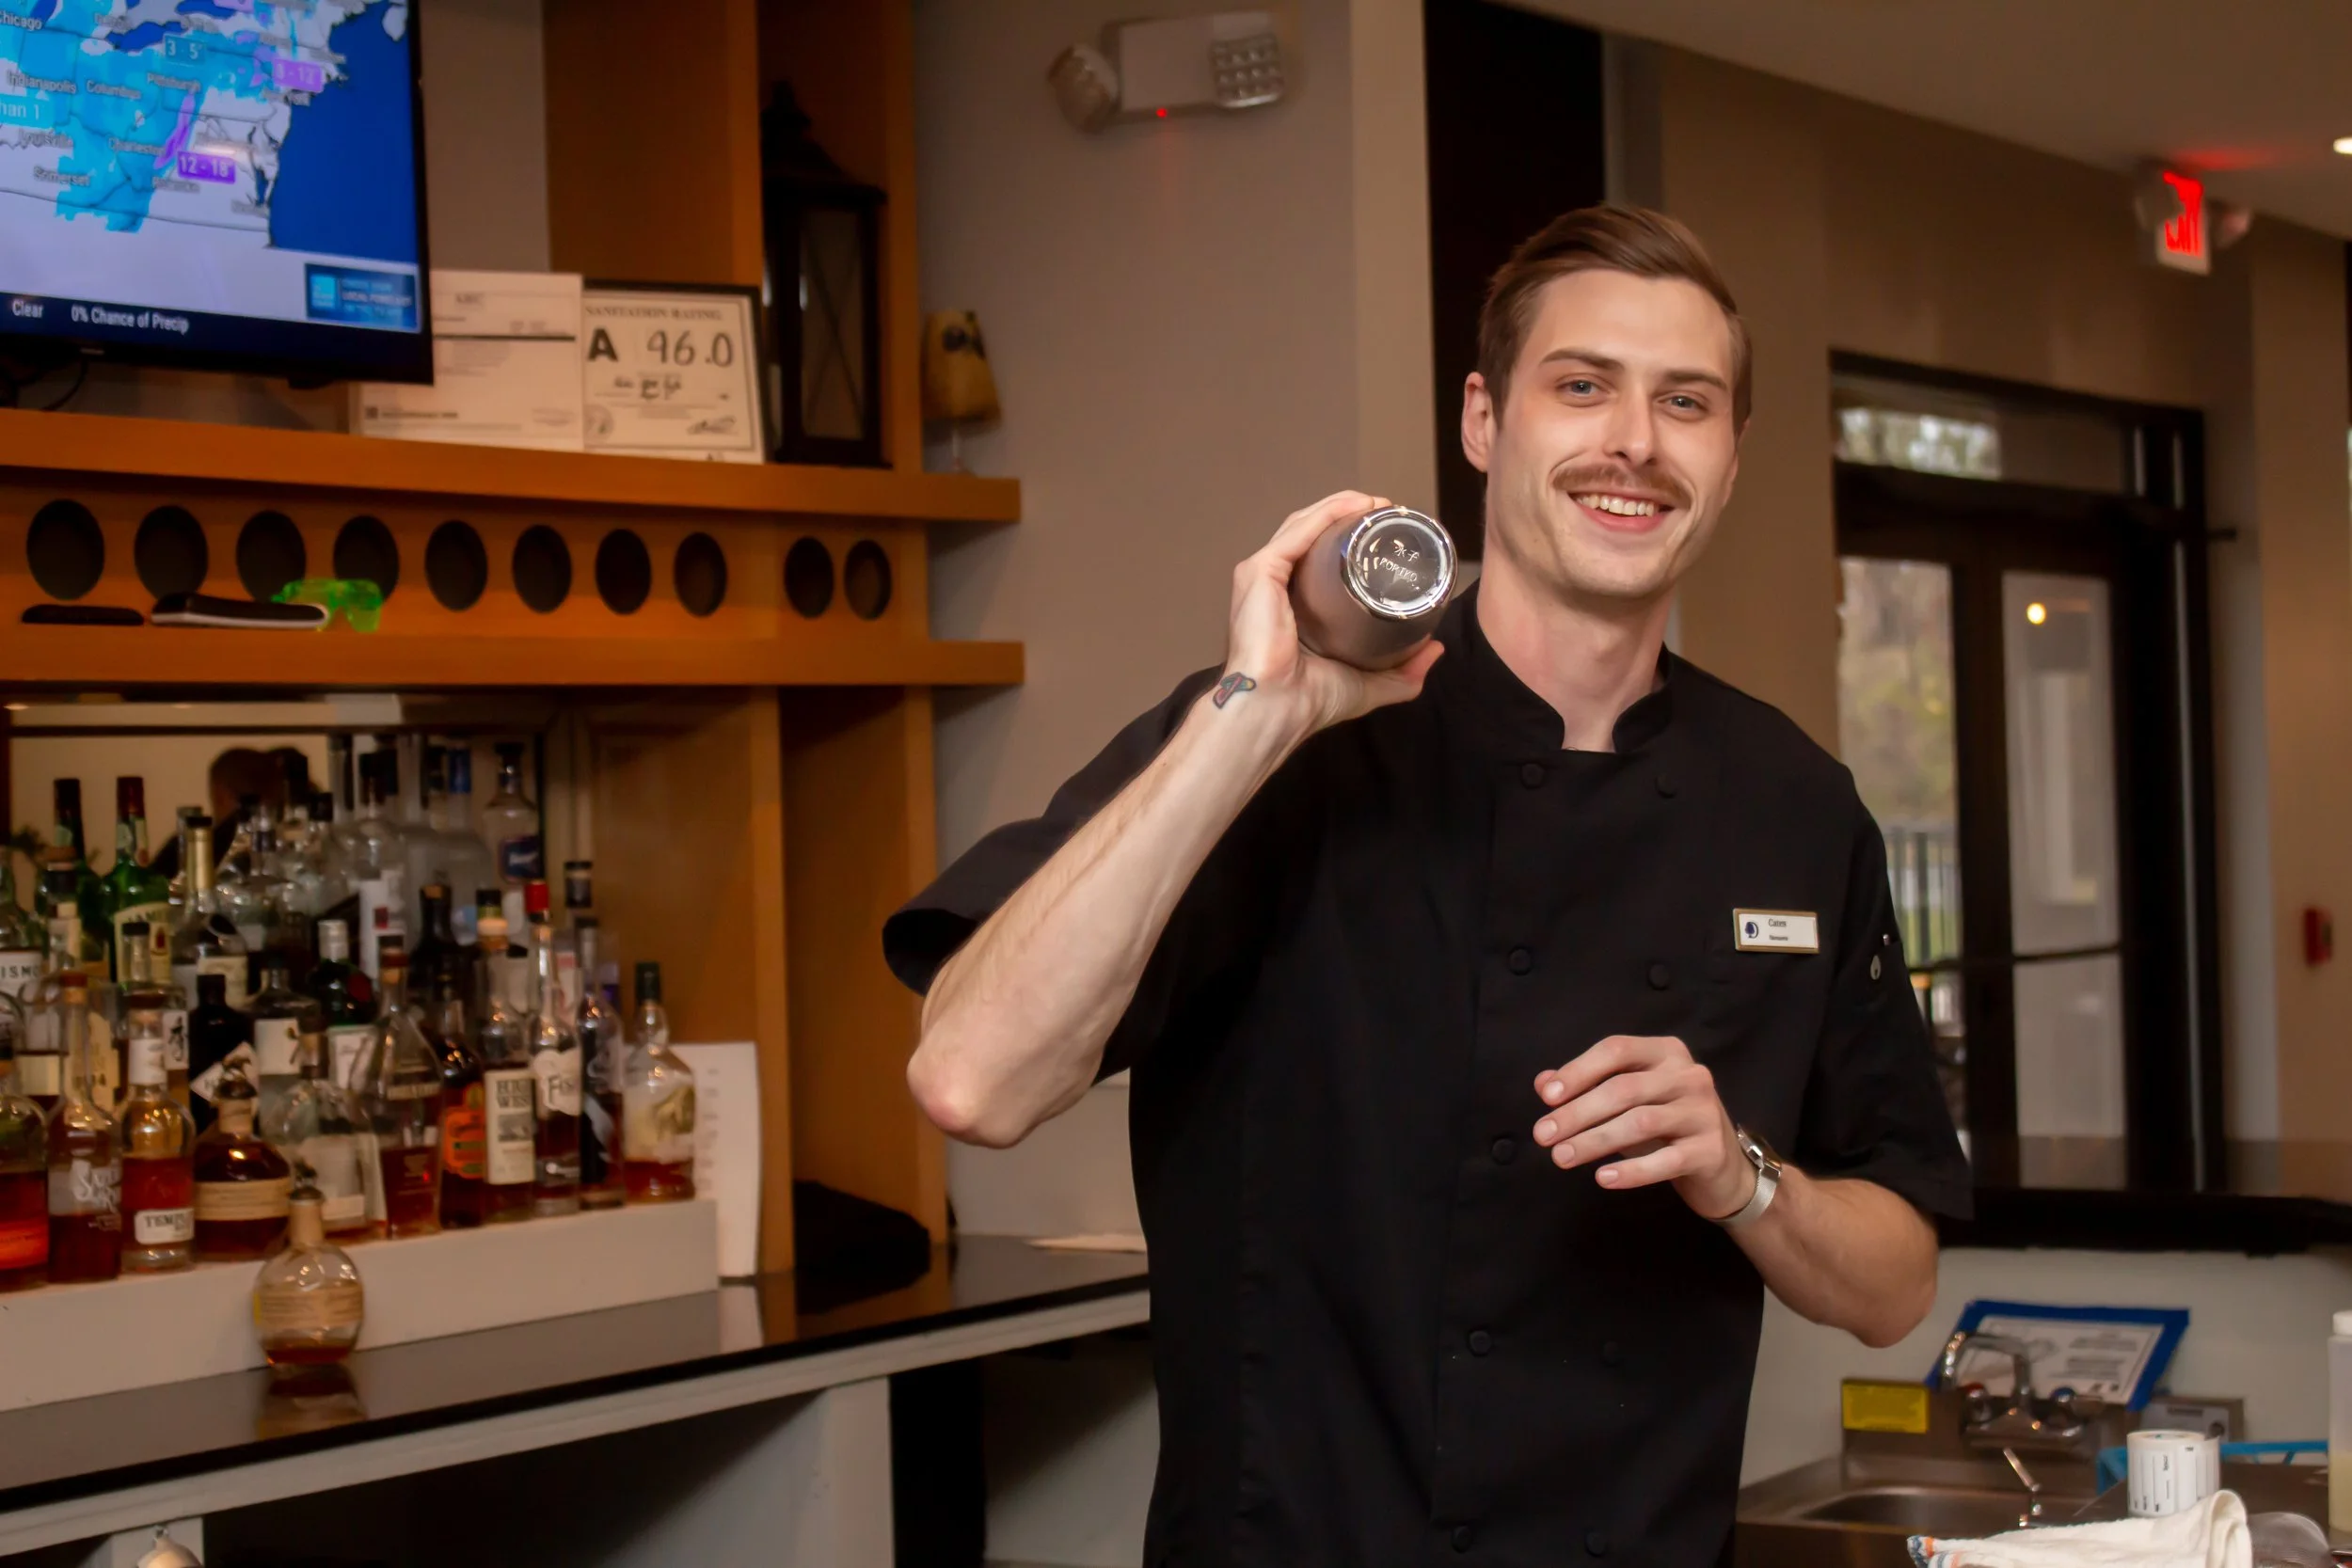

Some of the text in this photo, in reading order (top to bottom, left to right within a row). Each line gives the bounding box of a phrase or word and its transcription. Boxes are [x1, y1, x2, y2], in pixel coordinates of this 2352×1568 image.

[7, 71, 77, 93] Indianapolis
[180, 156, 198, 173] 12
[12, 300, 43, 320] Clear
[71, 304, 189, 337] 0% Chance of Precip
[587, 325, 619, 363] A
